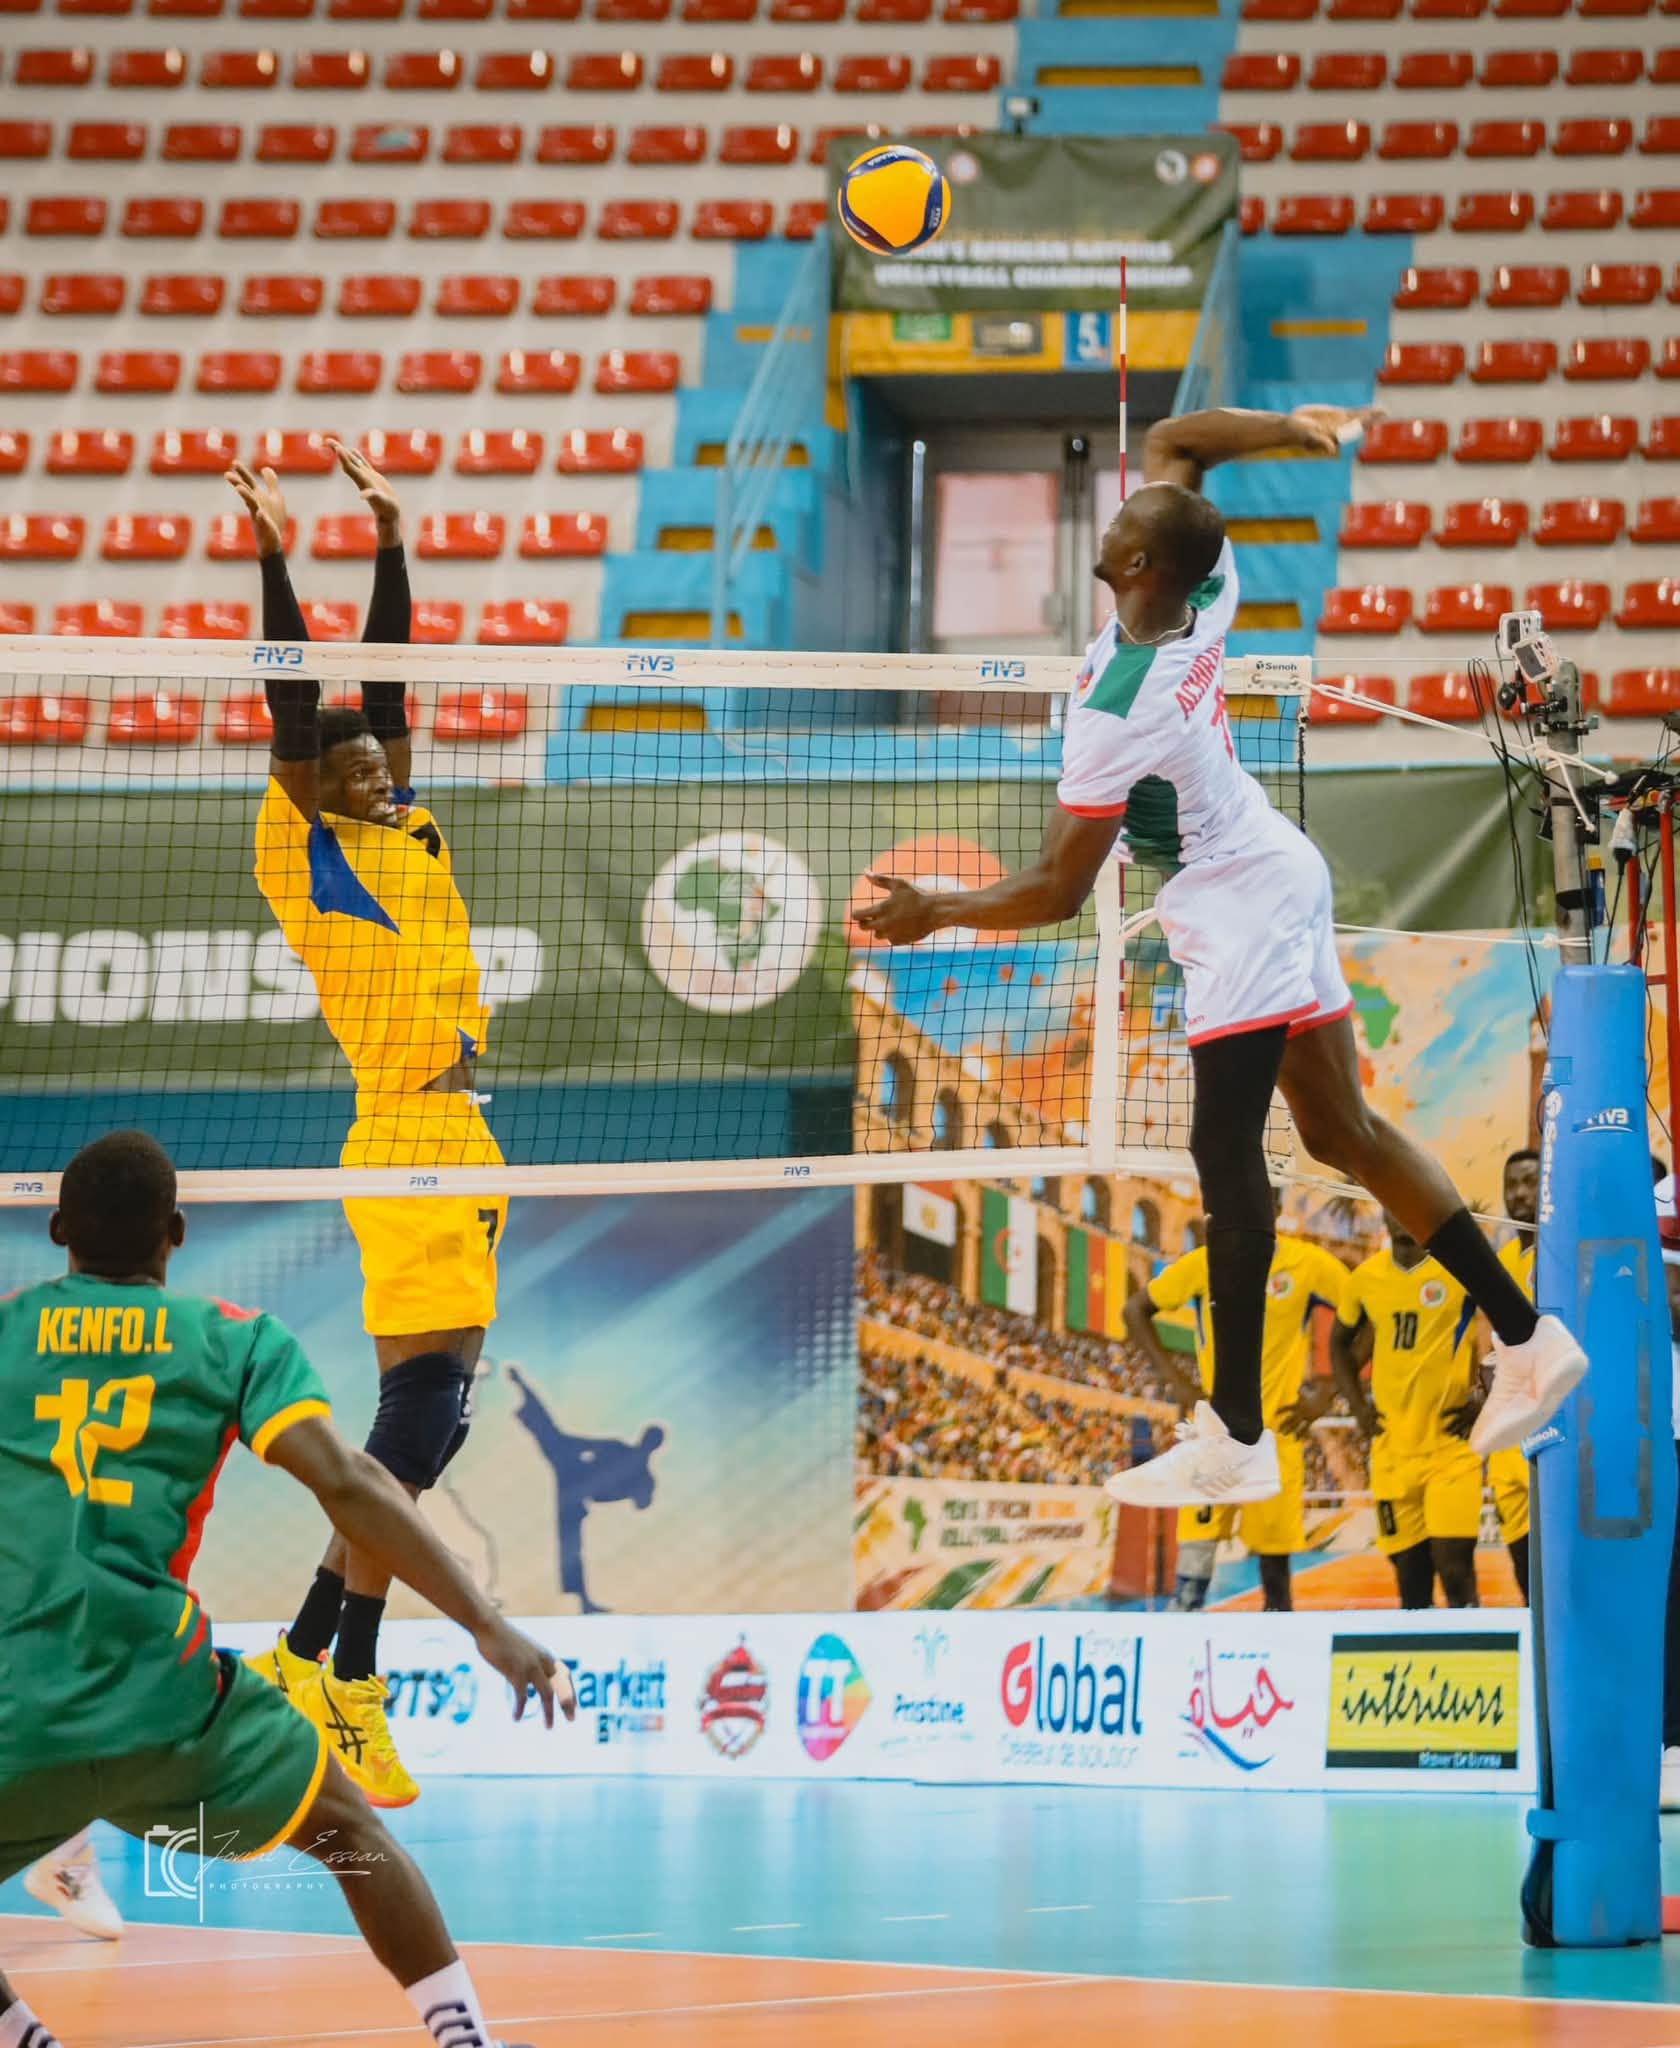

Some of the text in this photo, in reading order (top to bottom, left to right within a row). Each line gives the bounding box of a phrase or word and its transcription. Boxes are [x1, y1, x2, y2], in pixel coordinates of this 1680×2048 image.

[252, 646, 304, 665] FIVB
[626, 655, 675, 671] FIVB
[981, 660, 1025, 678] FIVB
[784, 1165, 810, 1177] FIVB
[14, 1182, 43, 1193] FIVB
[409, 1175, 438, 1187] FIVB
[477, 1208, 499, 1258] 7
[37, 1307, 173, 1354] KENFO.L
[1392, 1311, 1418, 1351] 10
[34, 1374, 156, 1508] 12
[1001, 1634, 1143, 1736] Global
